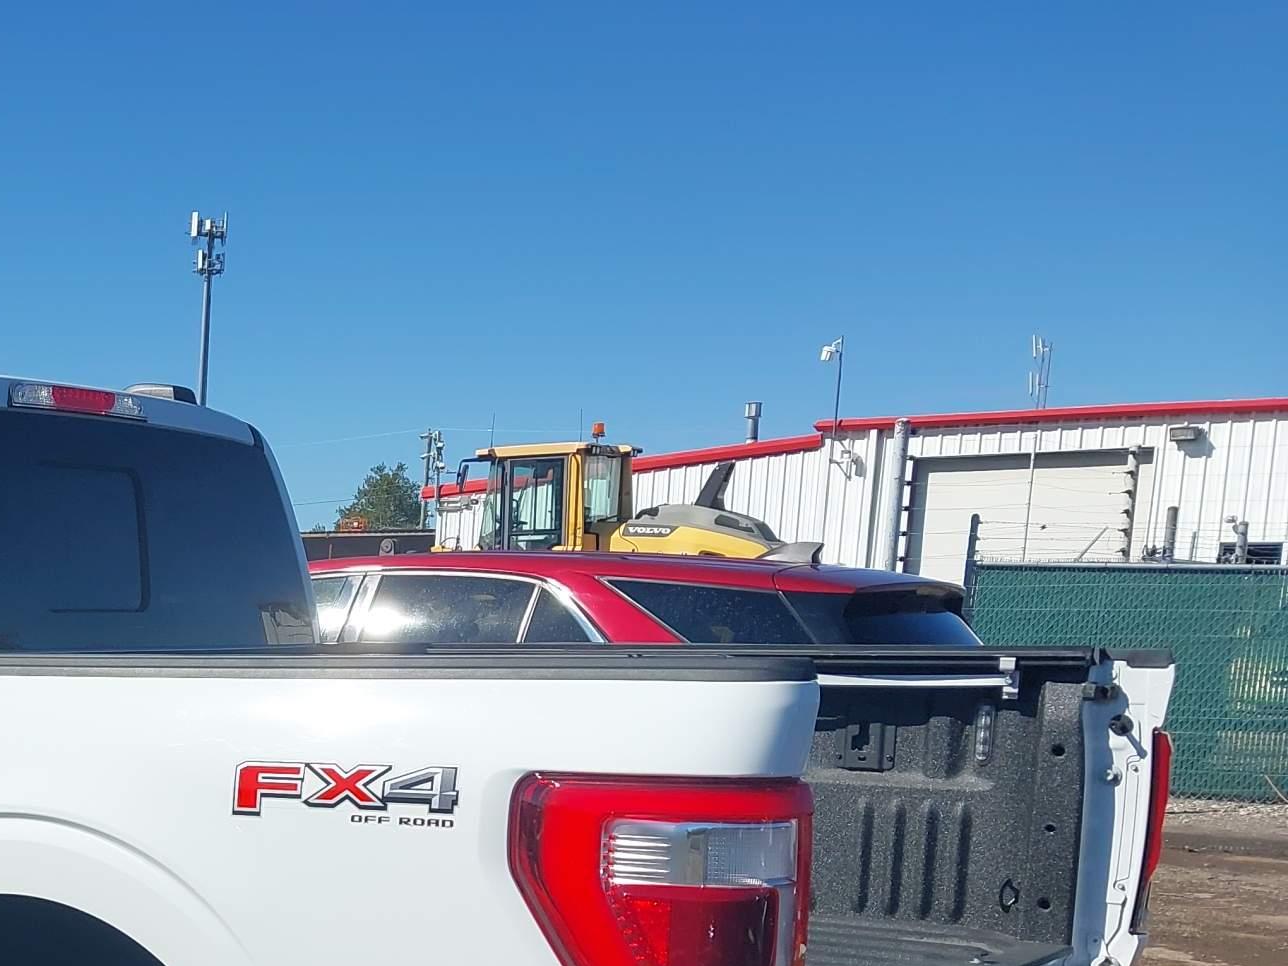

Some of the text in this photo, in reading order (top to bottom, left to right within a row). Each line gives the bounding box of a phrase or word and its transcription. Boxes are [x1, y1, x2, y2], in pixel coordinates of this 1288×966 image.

[627, 526, 672, 535] VOLVO
[232, 761, 459, 816] FX4
[350, 814, 454, 828] OFF ROAD
